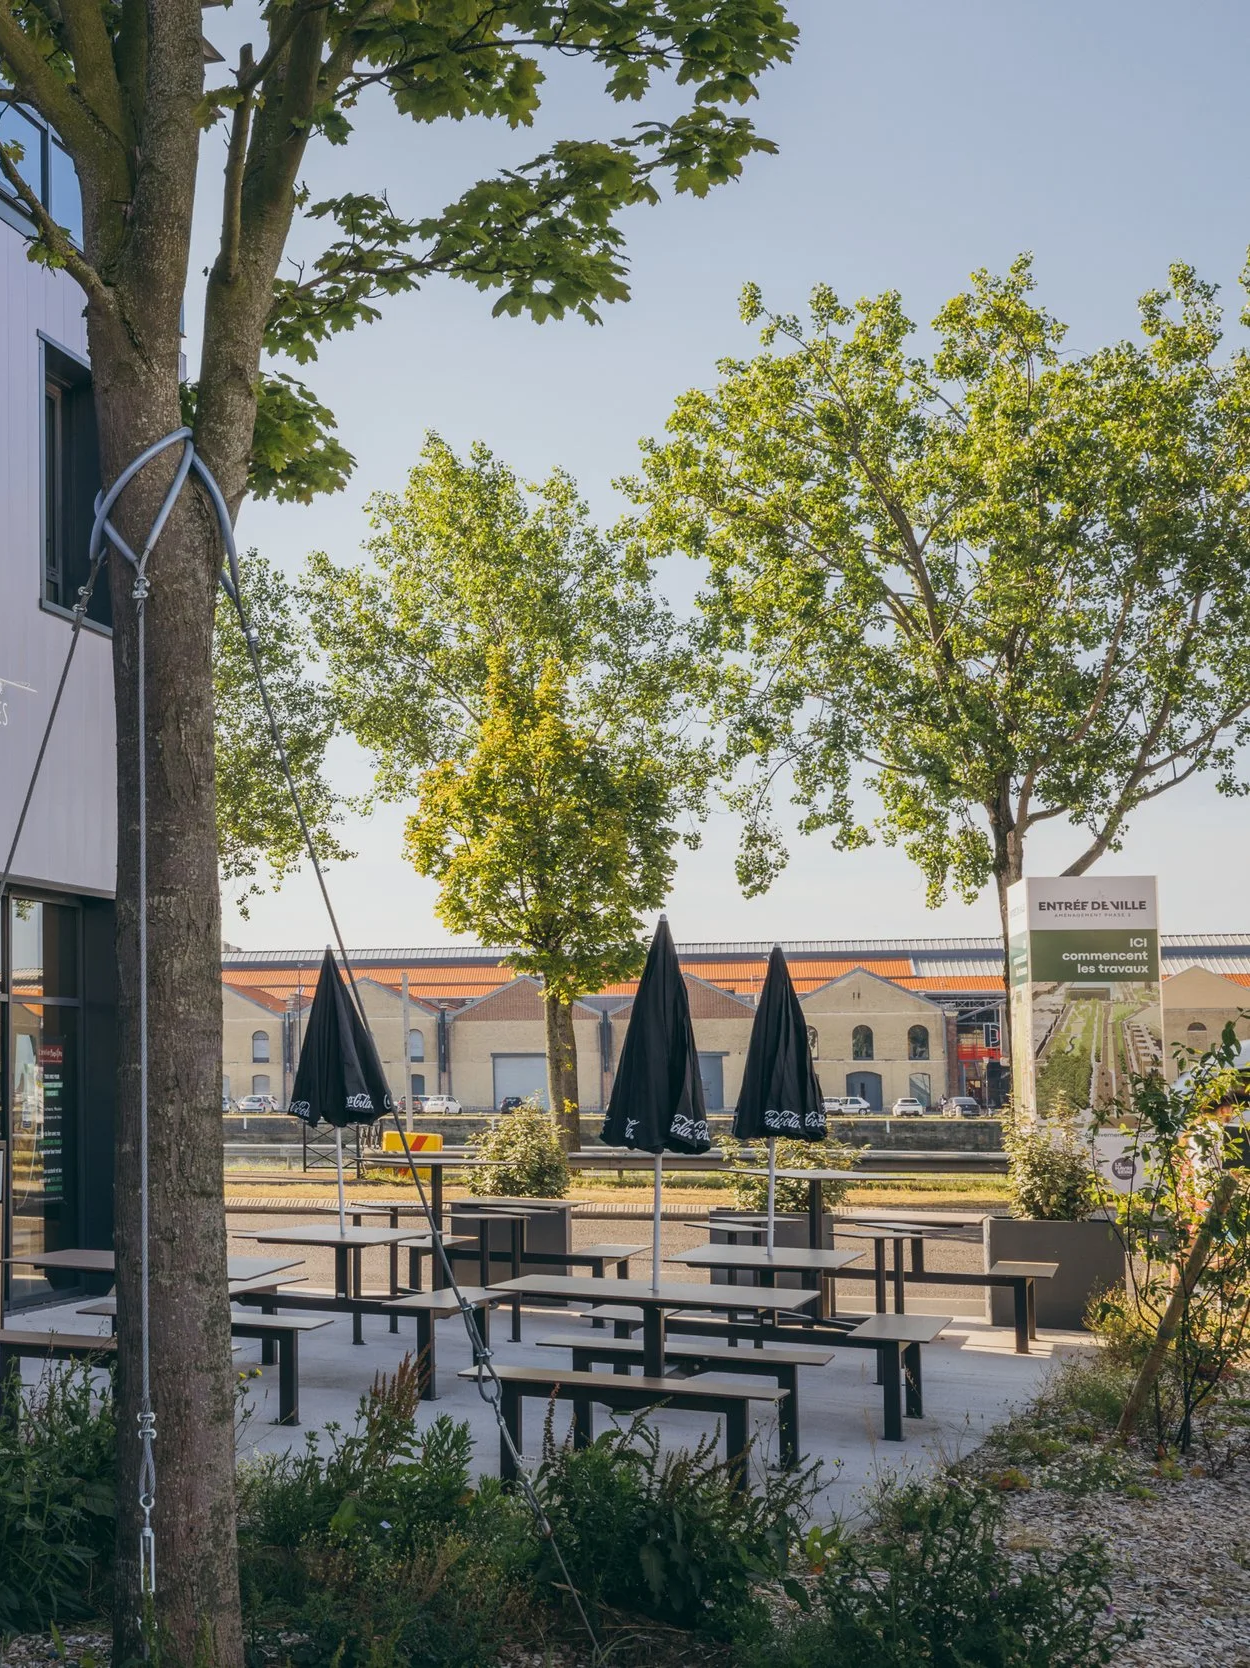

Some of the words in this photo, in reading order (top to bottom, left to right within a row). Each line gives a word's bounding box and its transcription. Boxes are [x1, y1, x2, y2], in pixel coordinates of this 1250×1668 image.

[1038, 898, 1088, 911] ENTRÉE
[1091, 901, 1110, 911] DE
[1110, 900, 1147, 910] VILLE
[1129, 938, 1148, 948] ICI
[1061, 951, 1149, 961] commencent
[1077, 963, 1095, 974] les
[1097, 963, 1149, 974] travaux
